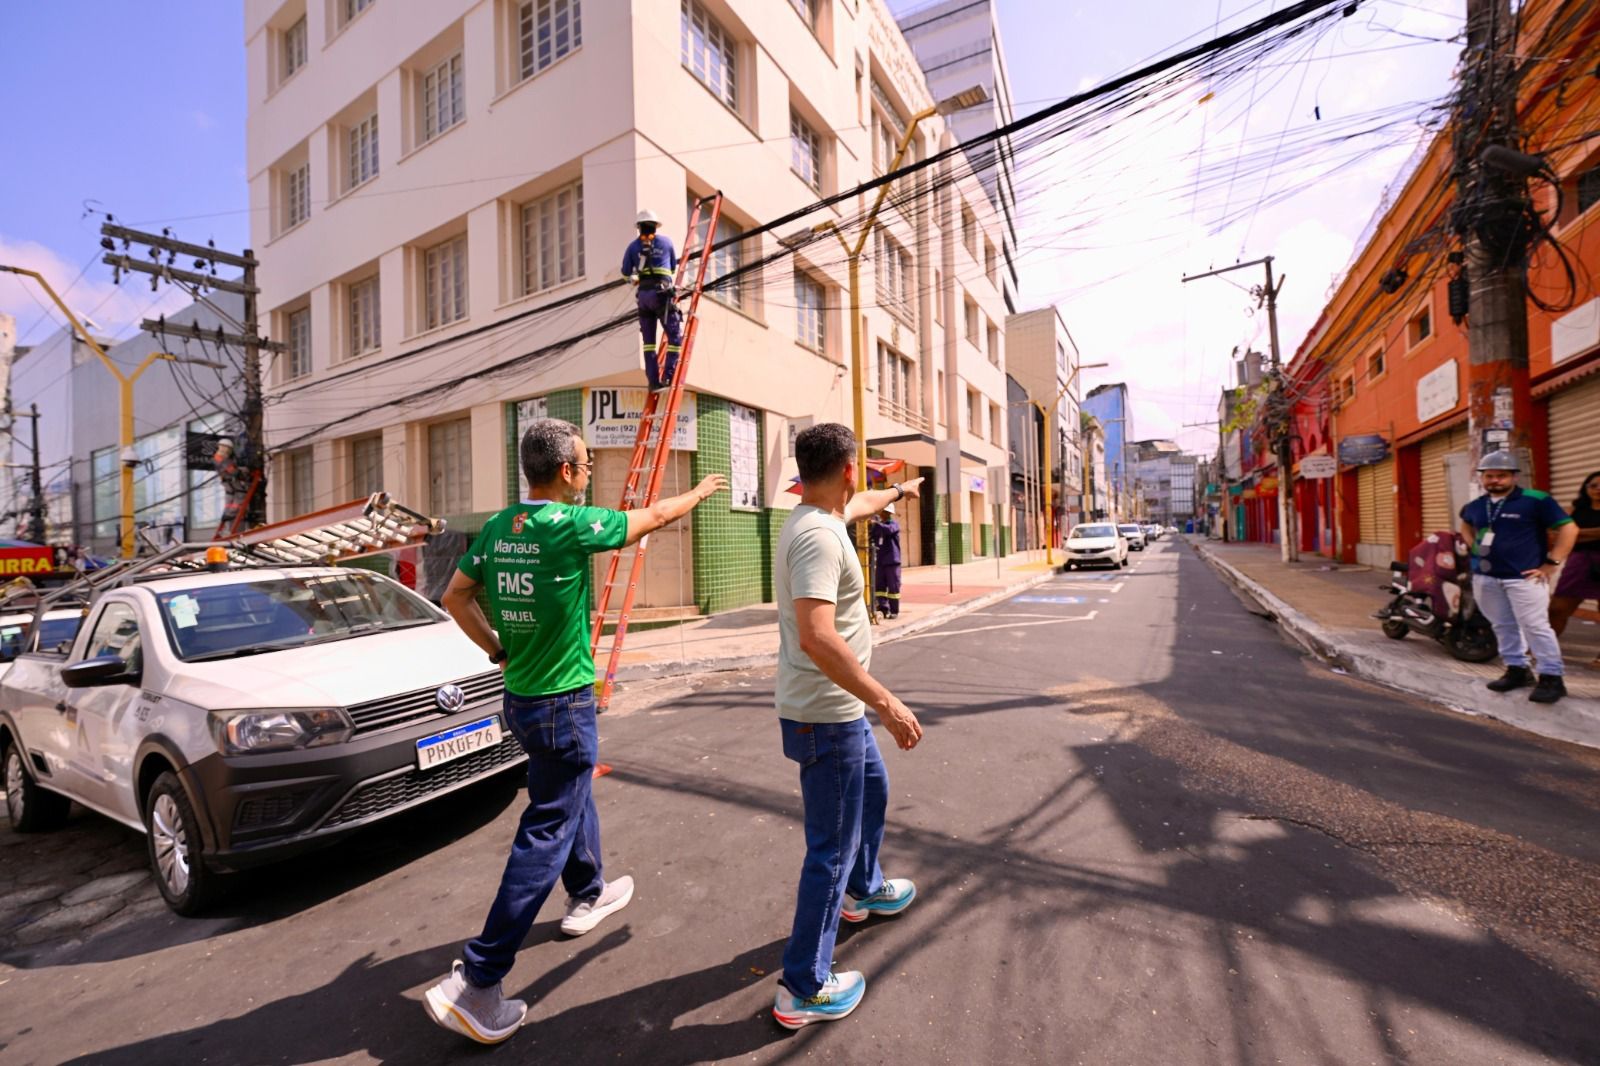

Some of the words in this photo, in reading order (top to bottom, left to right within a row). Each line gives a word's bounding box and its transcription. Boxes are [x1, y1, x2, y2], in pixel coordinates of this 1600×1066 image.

[588, 390, 626, 425] JPL
[620, 424, 636, 432] (92)
[494, 539, 540, 554] Manaus
[498, 572, 534, 596] FMS
[501, 610, 536, 622] SEMJEL
